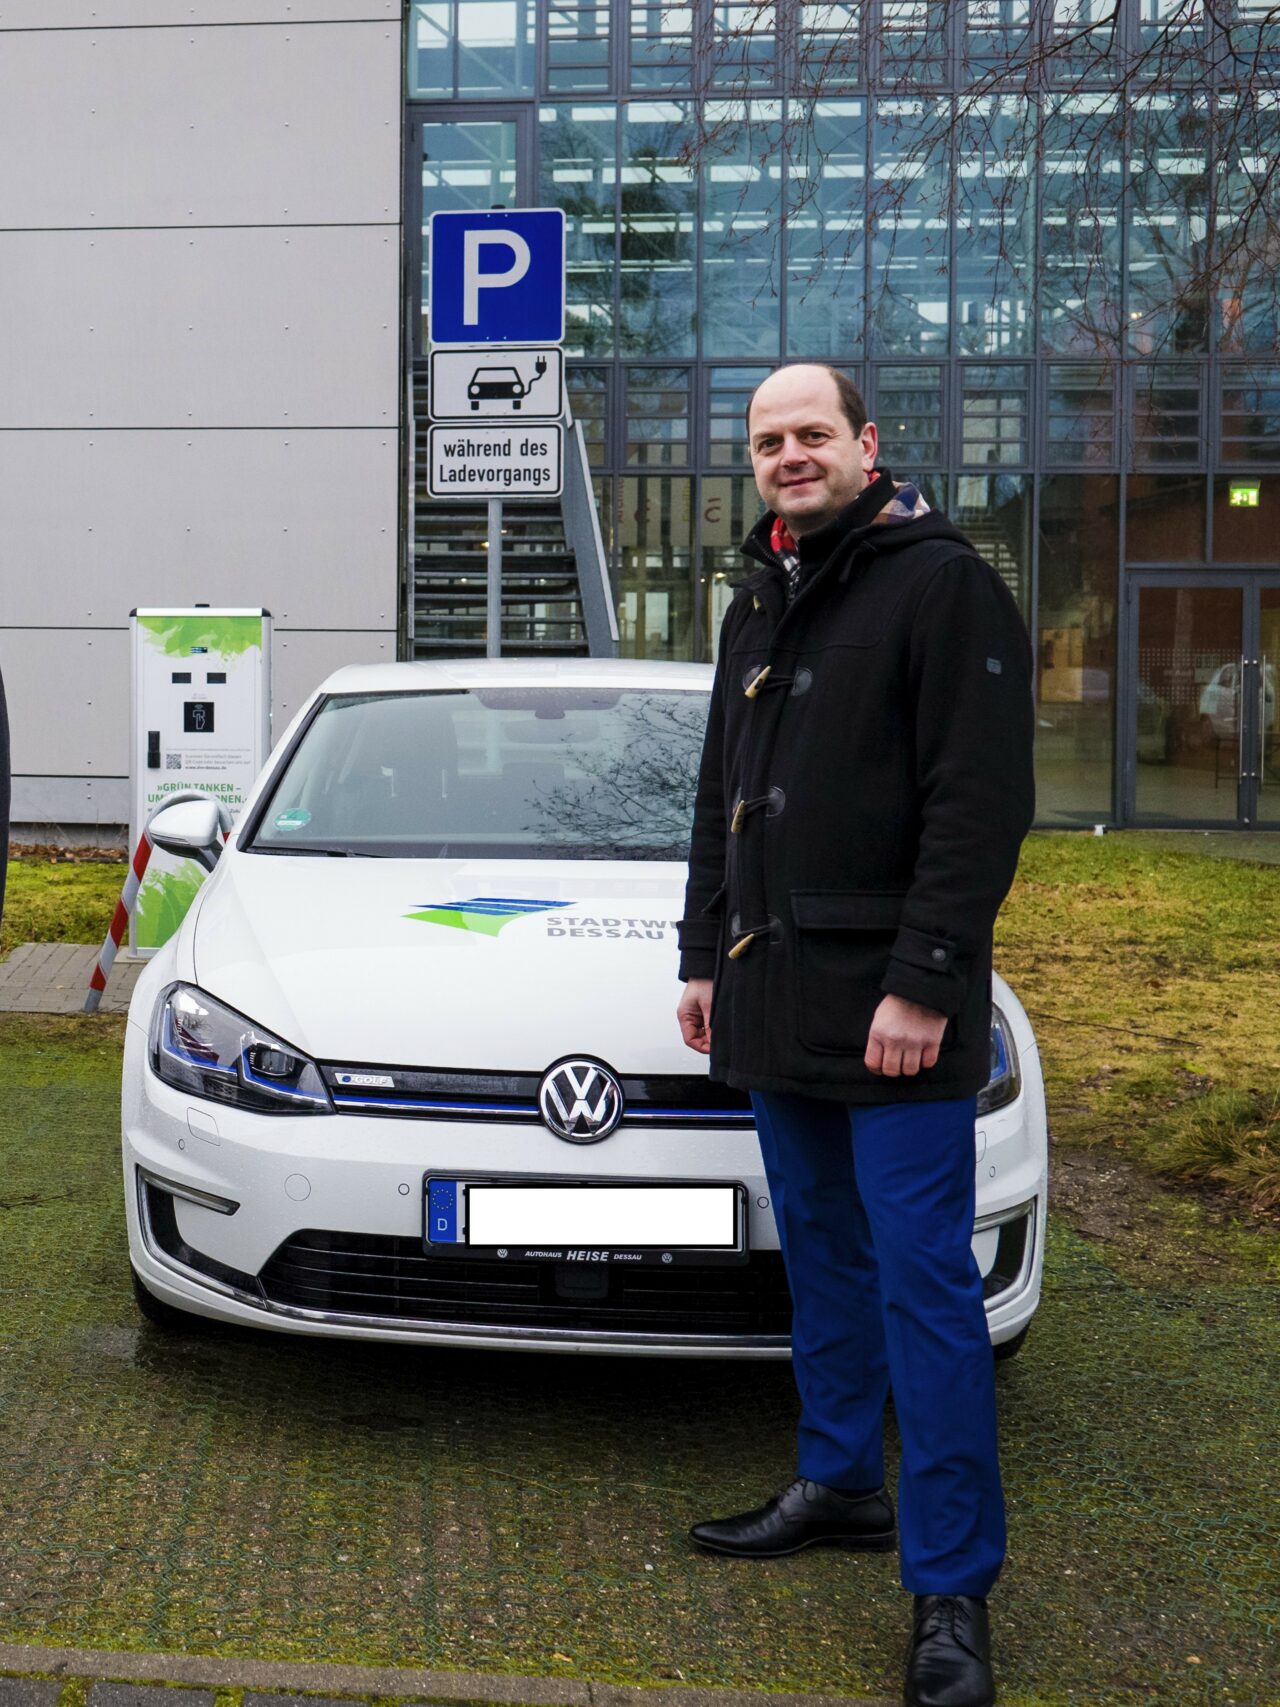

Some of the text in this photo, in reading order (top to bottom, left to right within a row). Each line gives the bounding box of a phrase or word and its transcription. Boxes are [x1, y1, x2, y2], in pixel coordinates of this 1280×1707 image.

[463, 229, 531, 326] P
[443, 438, 548, 457] während des
[439, 464, 551, 486] Ladevorgangs
[194, 783, 234, 792] TANKEN
[547, 927, 664, 940] DESSAU
[437, 1218, 448, 1231] D
[524, 1250, 562, 1258] AUTOHAUS
[566, 1250, 610, 1262] HEISE
